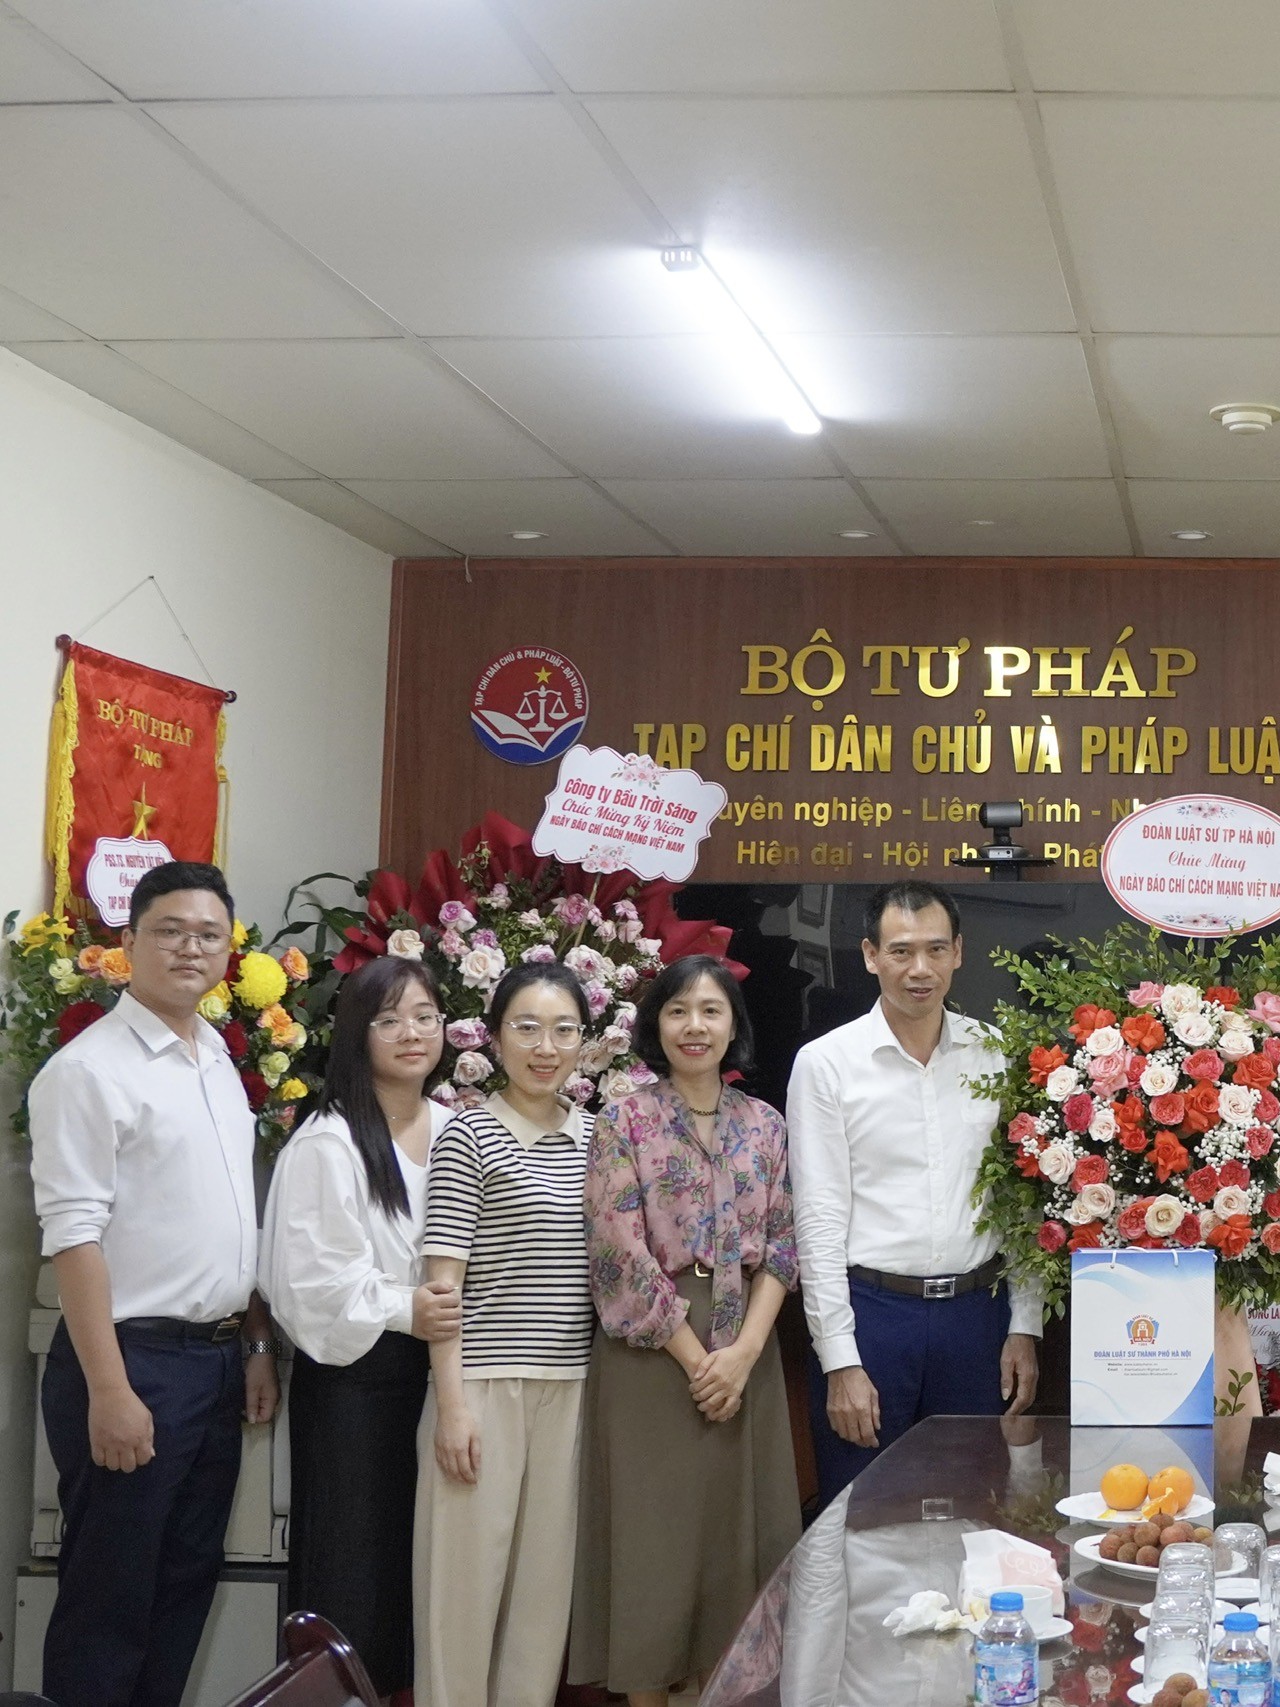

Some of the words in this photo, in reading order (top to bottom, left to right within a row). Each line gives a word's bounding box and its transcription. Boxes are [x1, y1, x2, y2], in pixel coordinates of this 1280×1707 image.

[516, 651, 523, 660] &
[524, 649, 546, 659] PHÁP
[545, 653, 565, 668] LUẬT
[572, 687, 585, 710] PHÁP
[740, 628, 845, 711] BỘ
[863, 637, 970, 697] TƯ
[983, 625, 1197, 698] PHÁP
[98, 698, 125, 729] BỘ
[129, 708, 150, 734] TƯ
[150, 716, 194, 747] PHÁP
[725, 715, 794, 772] CHÍ
[810, 714, 892, 772] DÂN
[912, 708, 992, 774] CHỦ
[1010, 714, 1061, 774] VÀ
[1081, 716, 1188, 774] PHÁP
[561, 798, 593, 816] Chúc
[594, 805, 631, 827] Mừng
[632, 813, 651, 832] Kỷ
[653, 818, 685, 837] Niệm
[564, 778, 596, 800] Công
[597, 785, 612, 804] ty
[612, 789, 637, 808] Bầu
[640, 795, 665, 814] Trời
[664, 801, 698, 824] Sáng
[717, 794, 784, 827] uyên
[794, 796, 893, 827] nghiệp
[1018, 797, 1081, 823] hính
[550, 814, 570, 827] NGÀY
[571, 818, 588, 831] BÁO
[588, 820, 602, 834] CHÍ
[602, 824, 624, 840] CÁCH
[624, 831, 648, 846] MẠNG
[649, 835, 667, 850] VIỆT
[666, 841, 686, 853] NAM
[1142, 822, 1172, 840] ĐOÀN
[1175, 824, 1202, 844] LUẬT
[1205, 826, 1221, 843] SƯ
[1223, 829, 1236, 843] TP
[1239, 827, 1253, 845] HÀ
[1257, 827, 1275, 848] NỘI
[811, 841, 853, 872] đại
[883, 841, 928, 872] Hội
[1044, 842, 1103, 868] Phá
[1168, 850, 1201, 867] Chúc
[1205, 853, 1247, 872] Mừng
[1119, 873, 1144, 891] NGÀY
[1147, 873, 1166, 893] BÁO
[1168, 874, 1186, 894] CHÍ
[1188, 875, 1214, 895] CÁCH
[1216, 880, 1244, 899] MẠNG
[1246, 878, 1268, 900] VIỆT
[1127, 1350, 1137, 1358] SƯ
[1137, 1349, 1157, 1358] THÀNH
[1171, 1349, 1180, 1358] HÀ
